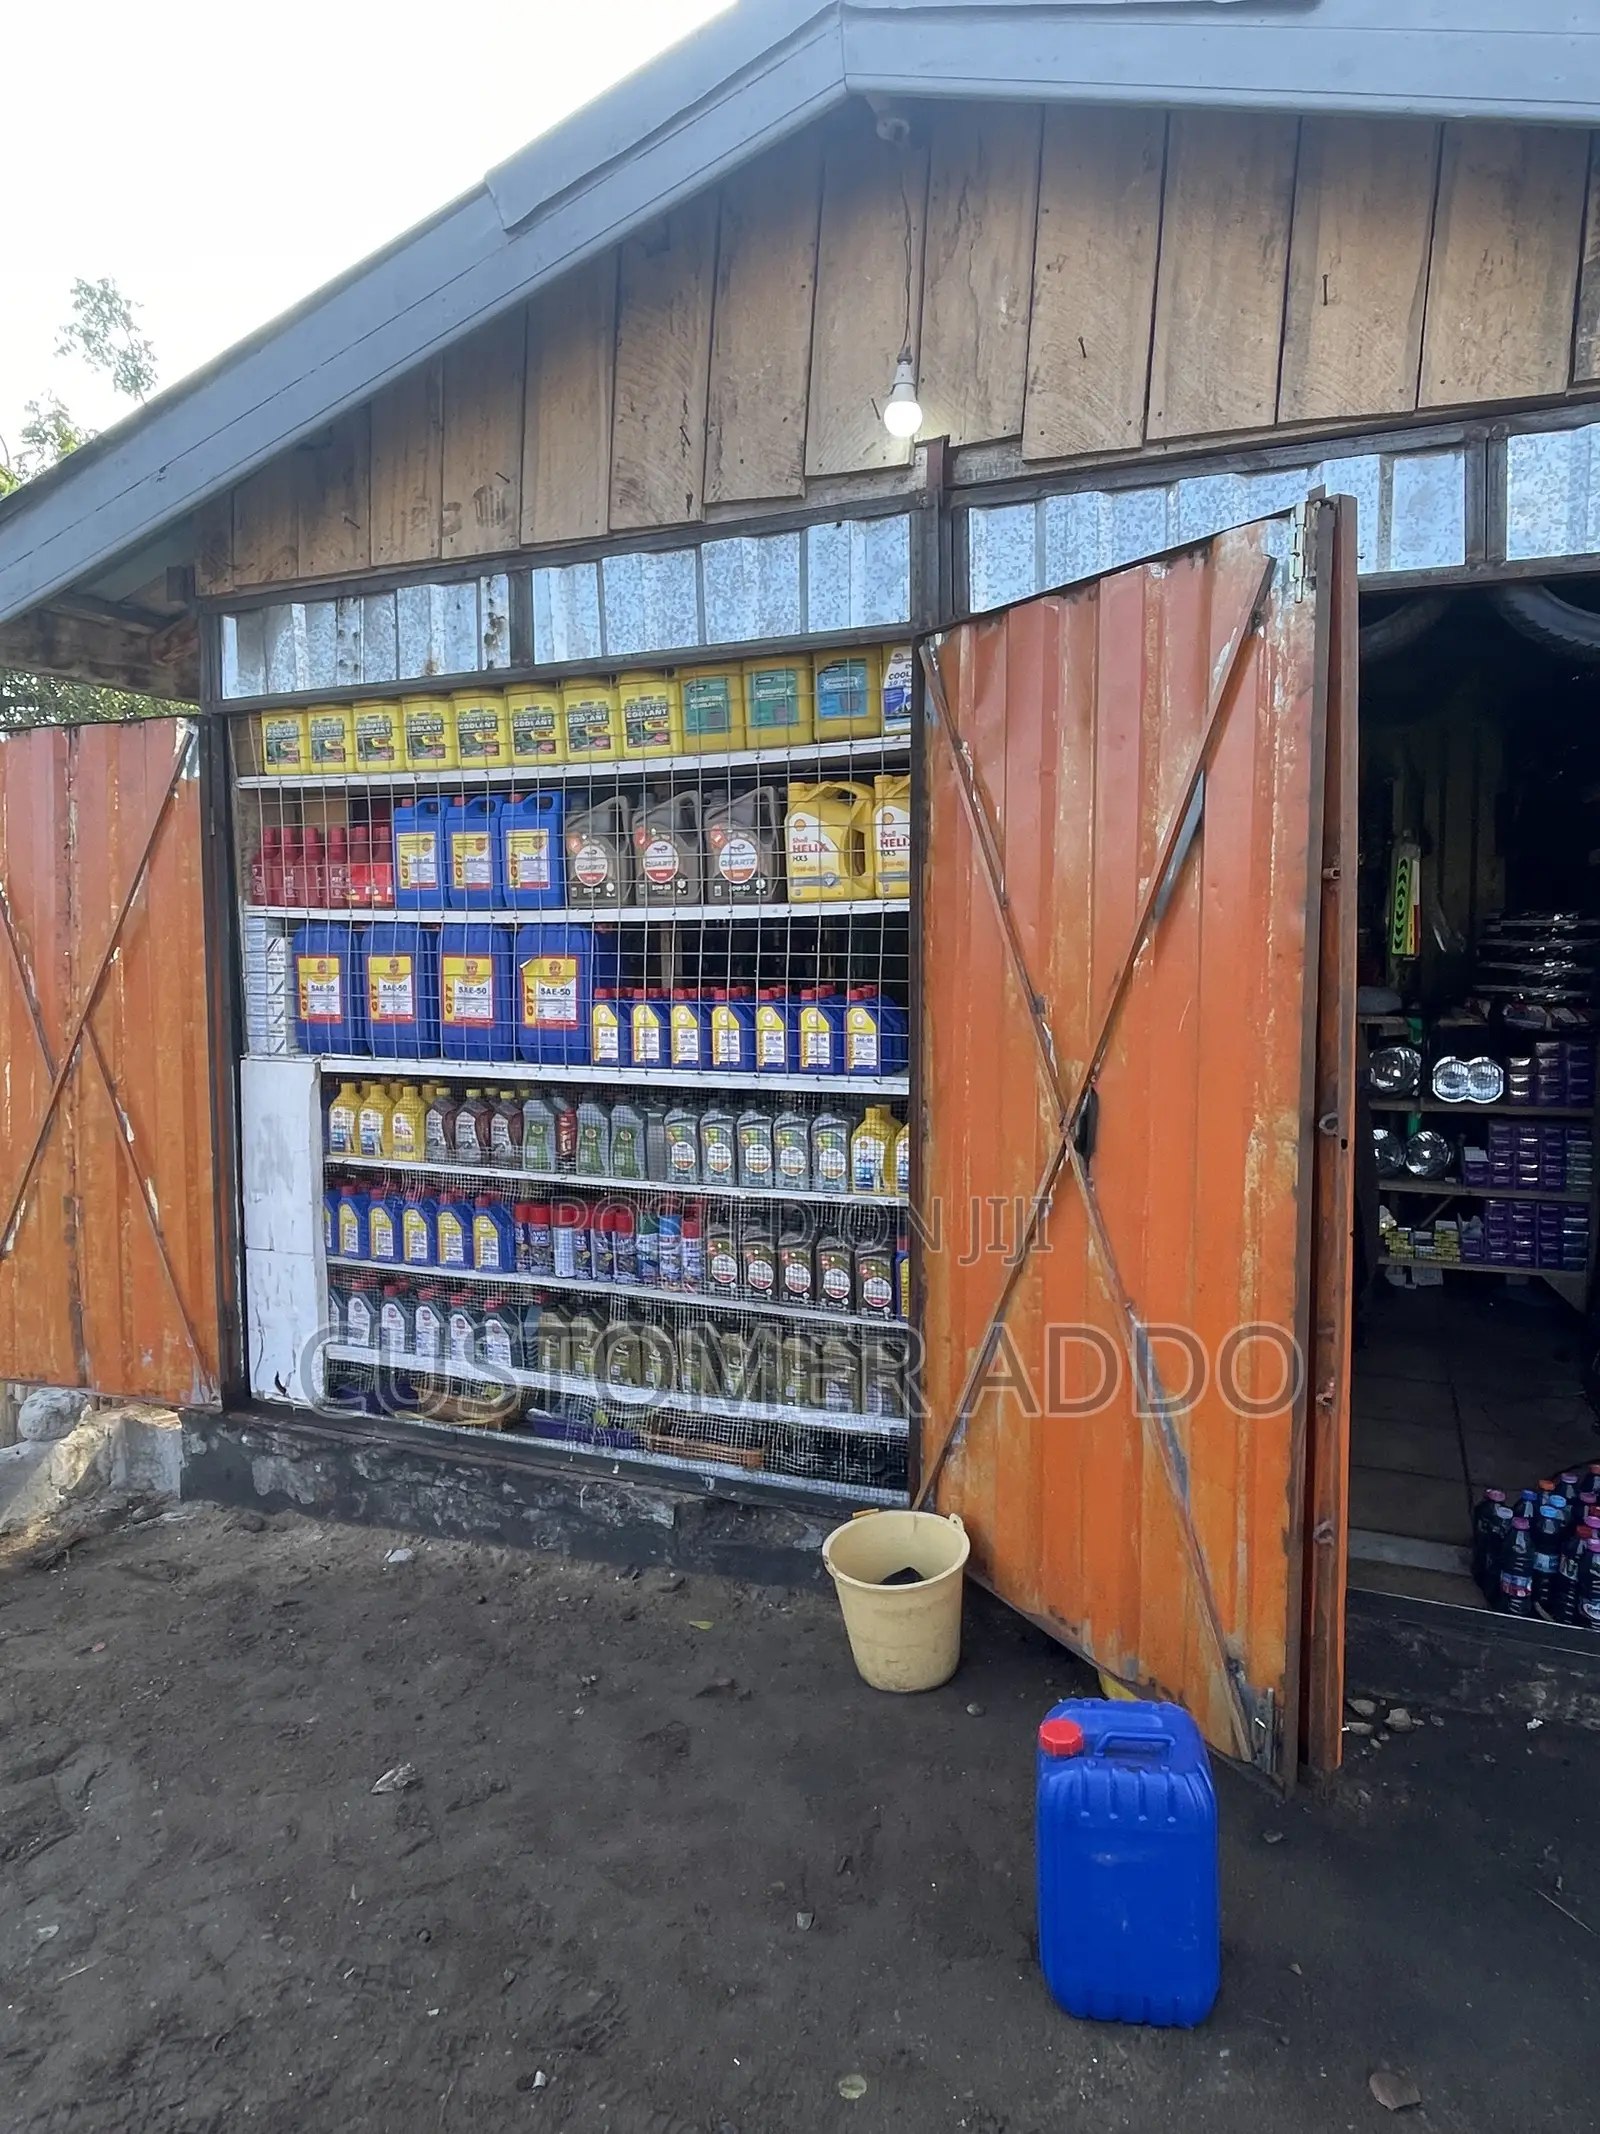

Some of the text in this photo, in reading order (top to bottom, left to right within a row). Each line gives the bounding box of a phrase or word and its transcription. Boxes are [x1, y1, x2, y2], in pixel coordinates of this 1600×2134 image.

[627, 709, 667, 718] COOLANT
[514, 719, 552, 728] COOLANT
[568, 714, 606, 724] COOLANT
[459, 721, 496, 730] COOLANT
[793, 840, 830, 853] HELIX
[880, 838, 910, 848] HELI
[720, 858, 756, 866] QUARTZ
[311, 984, 335, 992] SAE-50
[382, 984, 407, 992] SAE-50
[458, 986, 487, 995] SAE-50
[540, 988, 571, 996] SAE-50
